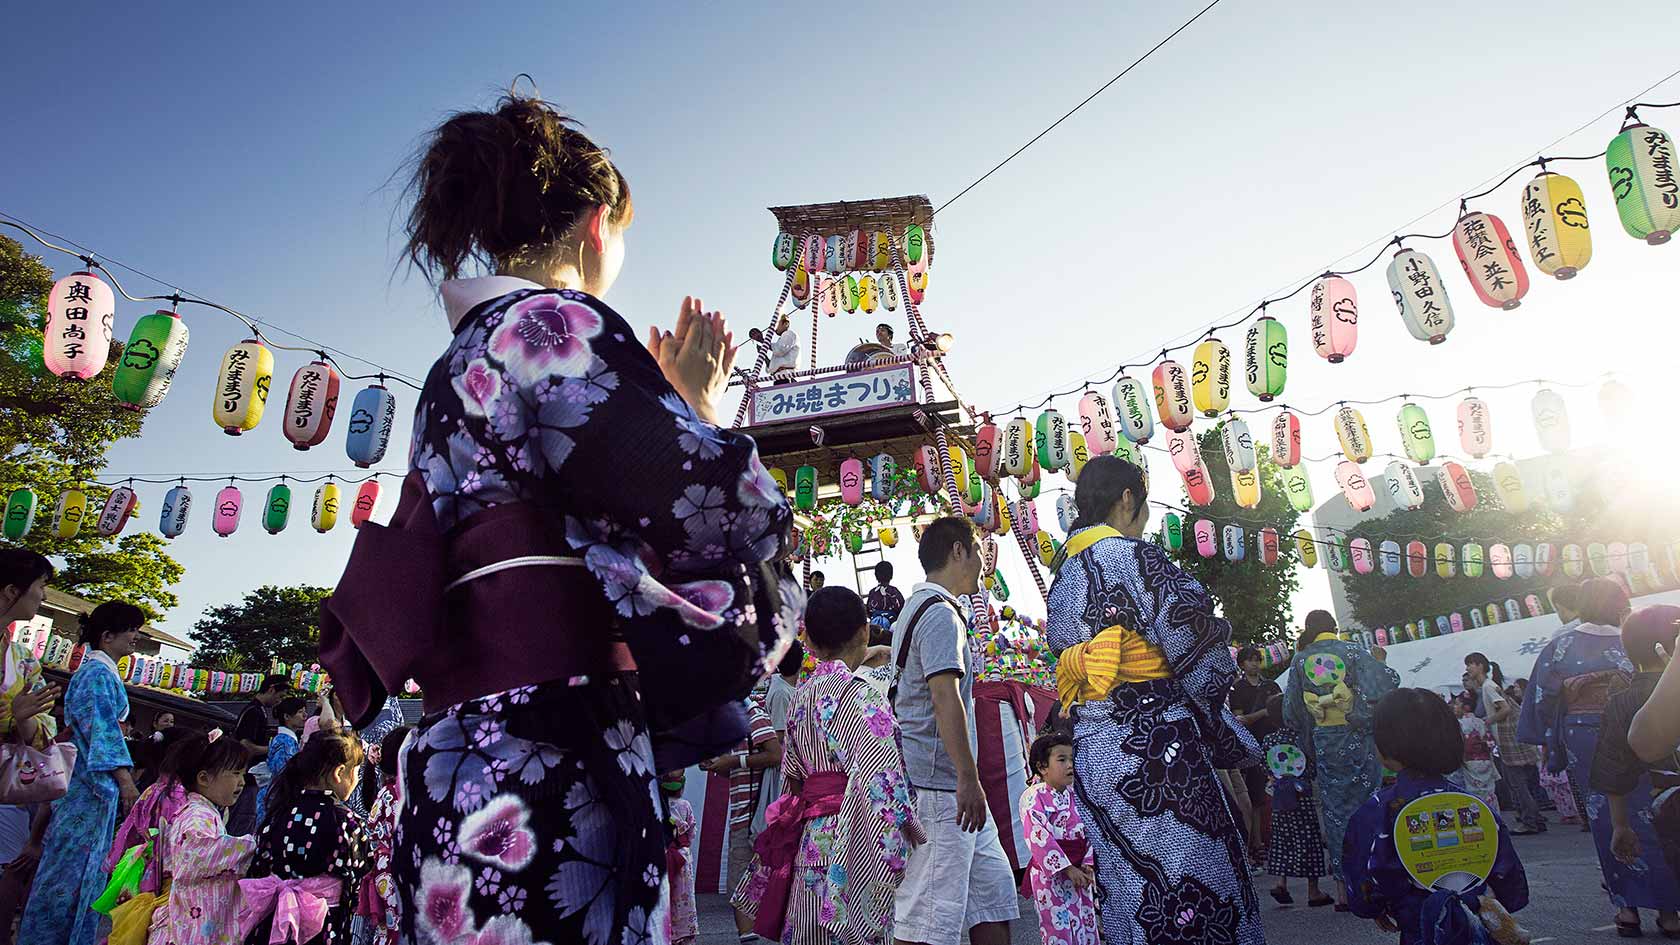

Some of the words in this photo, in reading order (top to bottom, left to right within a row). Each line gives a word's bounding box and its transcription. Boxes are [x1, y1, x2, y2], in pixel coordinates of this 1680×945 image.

[1644, 131, 1680, 208] みたままつり
[1405, 258, 1444, 328] 小野田久信
[62, 281, 92, 359] 奥田尚子
[222, 348, 250, 413] みたままつり
[1218, 346, 1231, 400] みたままつり
[1246, 327, 1259, 384] みたままつり
[294, 370, 321, 428] みたままつり
[772, 377, 891, 415] み魂まつり
[1120, 383, 1144, 430] みたままつり
[1169, 366, 1188, 415] みたままつり
[1052, 416, 1065, 461] みたままつり
[1093, 395, 1115, 442] 市川由美
[1471, 403, 1486, 444] みたままつり
[1008, 424, 1021, 468] みたままつり
